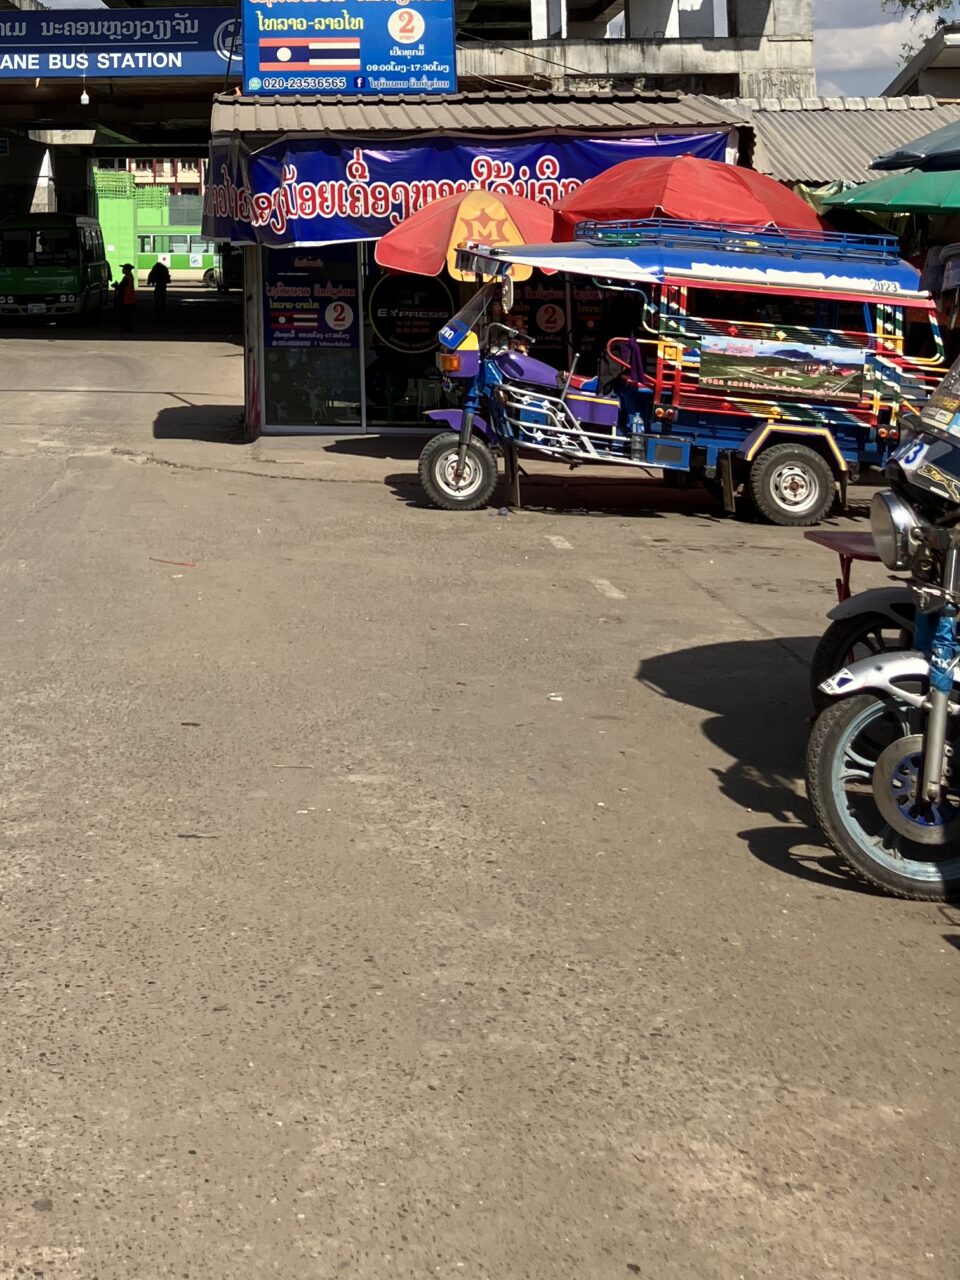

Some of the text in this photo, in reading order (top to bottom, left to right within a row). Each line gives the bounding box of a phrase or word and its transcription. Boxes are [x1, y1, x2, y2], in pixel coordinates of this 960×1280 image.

[40, 13, 199, 39] ນະຄອນຫຼວງວຽງຈັນ
[398, 10, 415, 33] 2
[48, 53, 89, 69] BUS
[97, 52, 183, 68] STATION
[263, 77, 346, 89] 020-23536565
[473, 220, 504, 241] M
[333, 304, 346, 322] 2
[544, 306, 557, 324] 2
